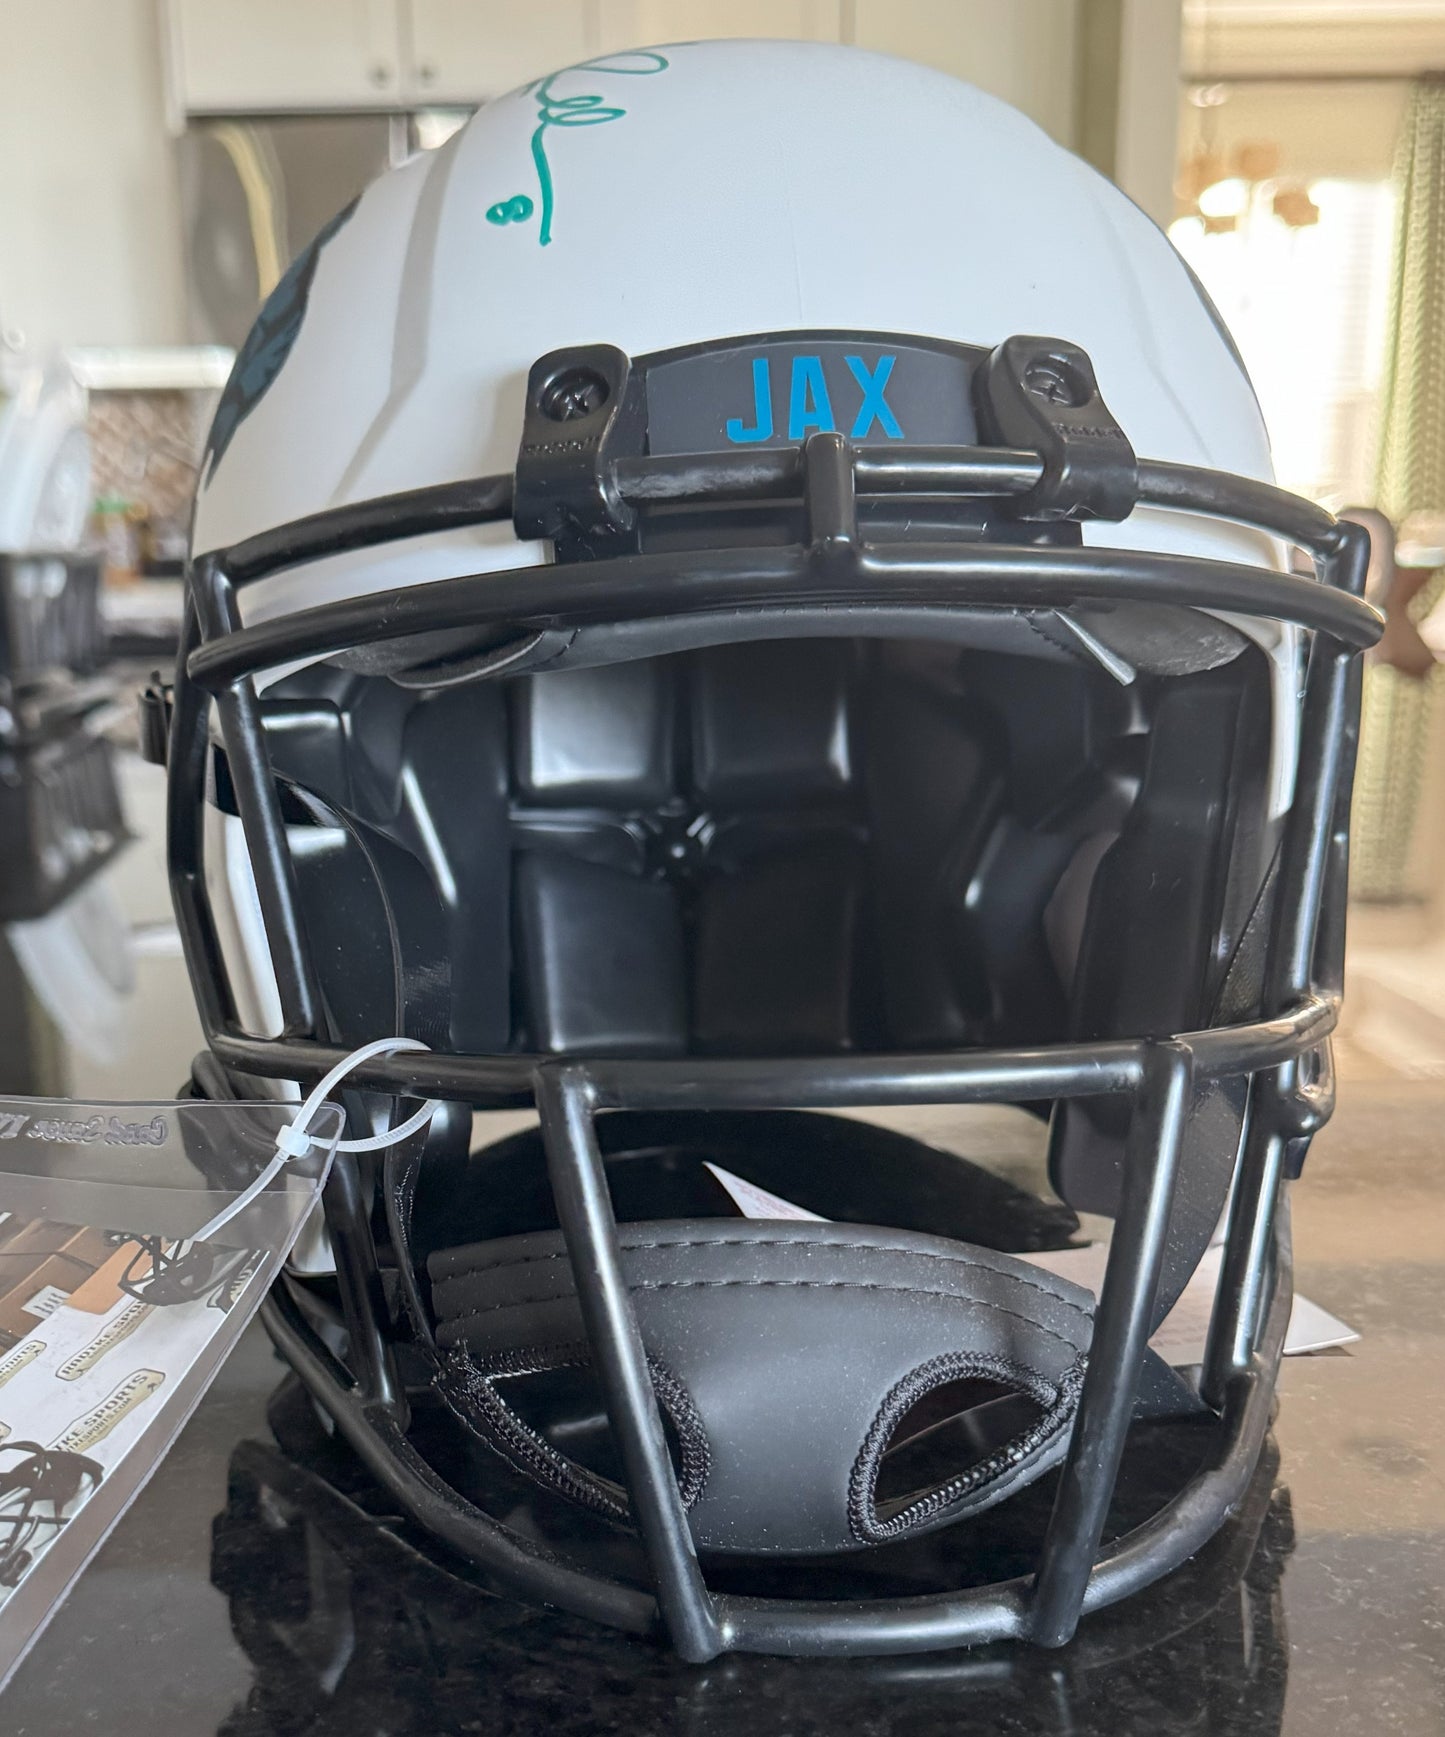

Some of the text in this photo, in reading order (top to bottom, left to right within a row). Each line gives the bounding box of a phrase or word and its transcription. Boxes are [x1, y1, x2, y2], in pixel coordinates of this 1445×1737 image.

[726, 355, 905, 443] JAX
[61, 1329, 115, 1376] RADTKE
[113, 1300, 146, 1329] SPO
[84, 1373, 148, 1427] SPORTS
